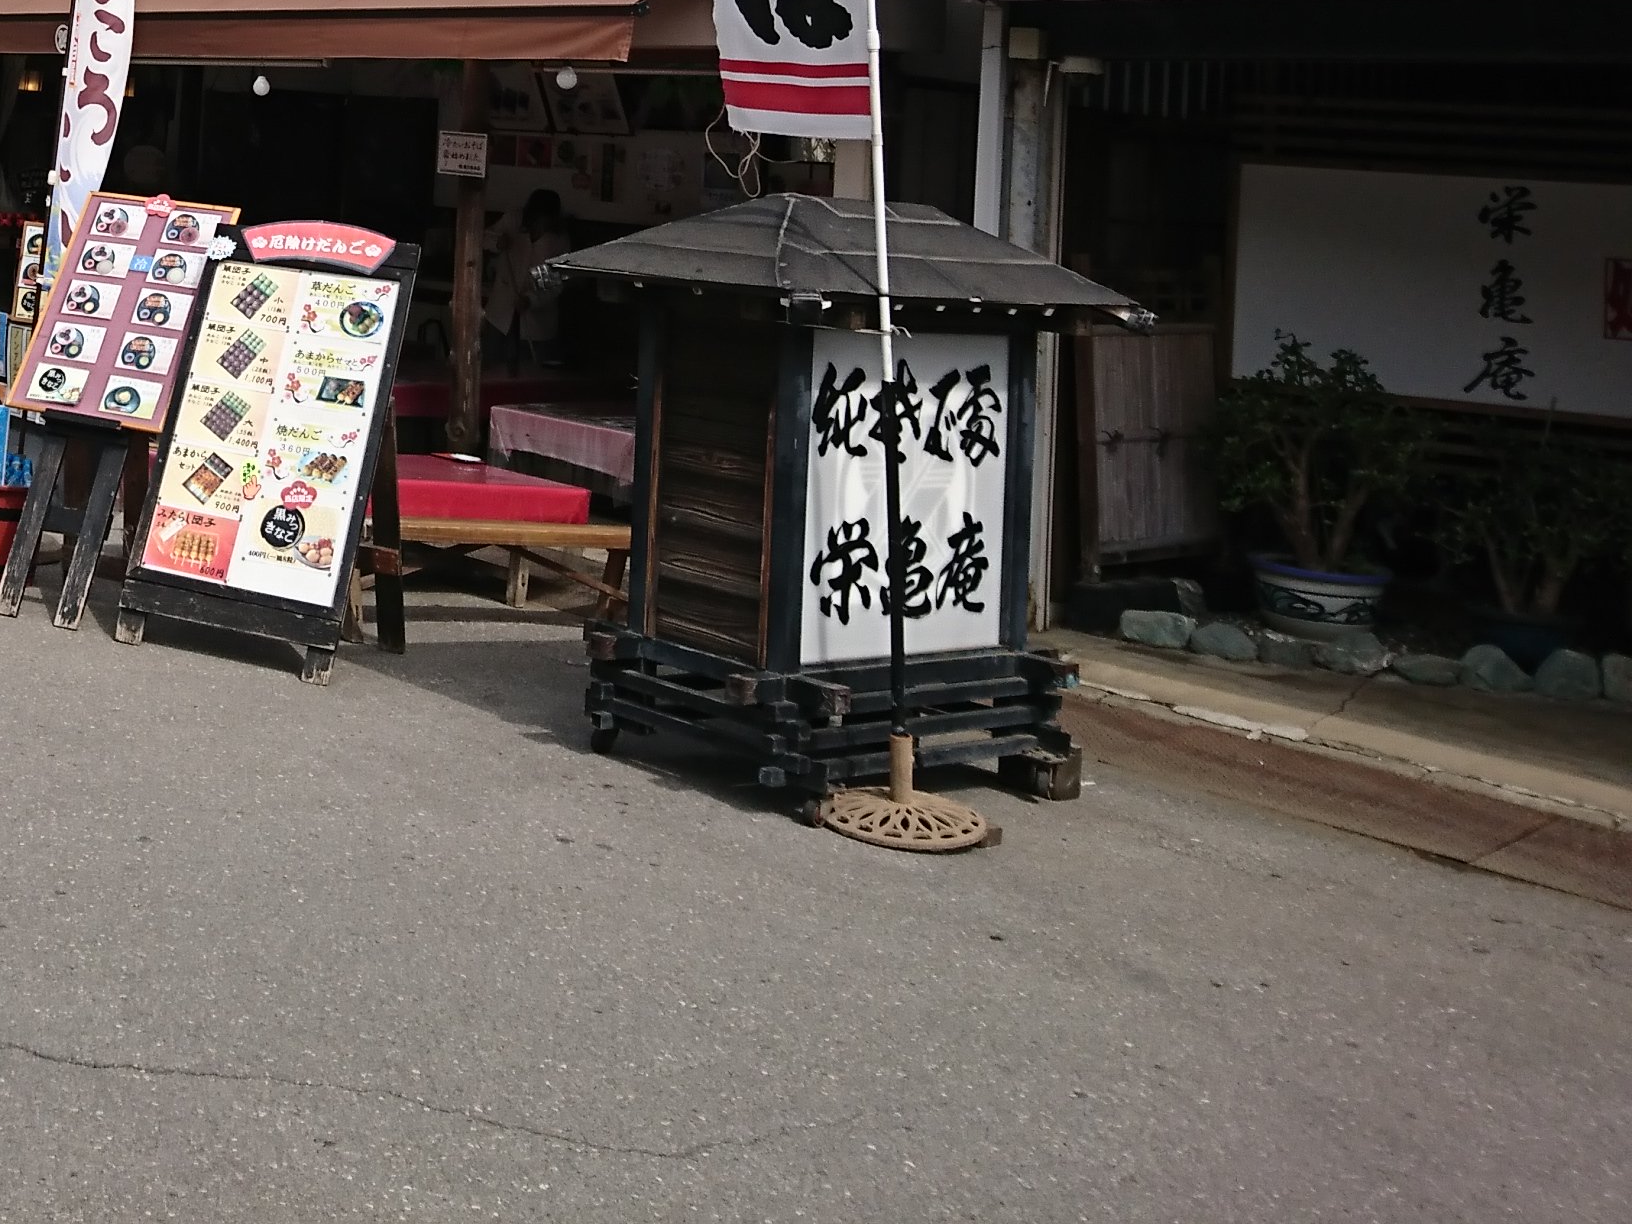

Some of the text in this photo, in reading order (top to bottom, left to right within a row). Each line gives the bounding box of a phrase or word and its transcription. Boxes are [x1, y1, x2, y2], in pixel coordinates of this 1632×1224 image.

[268, 234, 367, 256] 厄除けだんご
[133, 257, 147, 271] 冷
[311, 281, 356, 295] 草だんご
[1464, 185, 1538, 402] 栄亀庵
[273, 297, 284, 305] 小
[315, 299, 345, 310] 400円
[260, 313, 287, 326] 700円
[296, 366, 326, 377] 500円
[275, 424, 322, 441] 焼だんご
[172, 446, 208, 460] あまから
[279, 443, 310, 454] 360円
[179, 461, 196, 471] セット
[214, 500, 240, 514] 900円
[156, 508, 217, 528] みたらし団子
[272, 507, 299, 531] 黒みつ
[264, 520, 295, 543] きなこ
[199, 565, 225, 578] 600円
[809, 511, 990, 626] 栄亀庵
